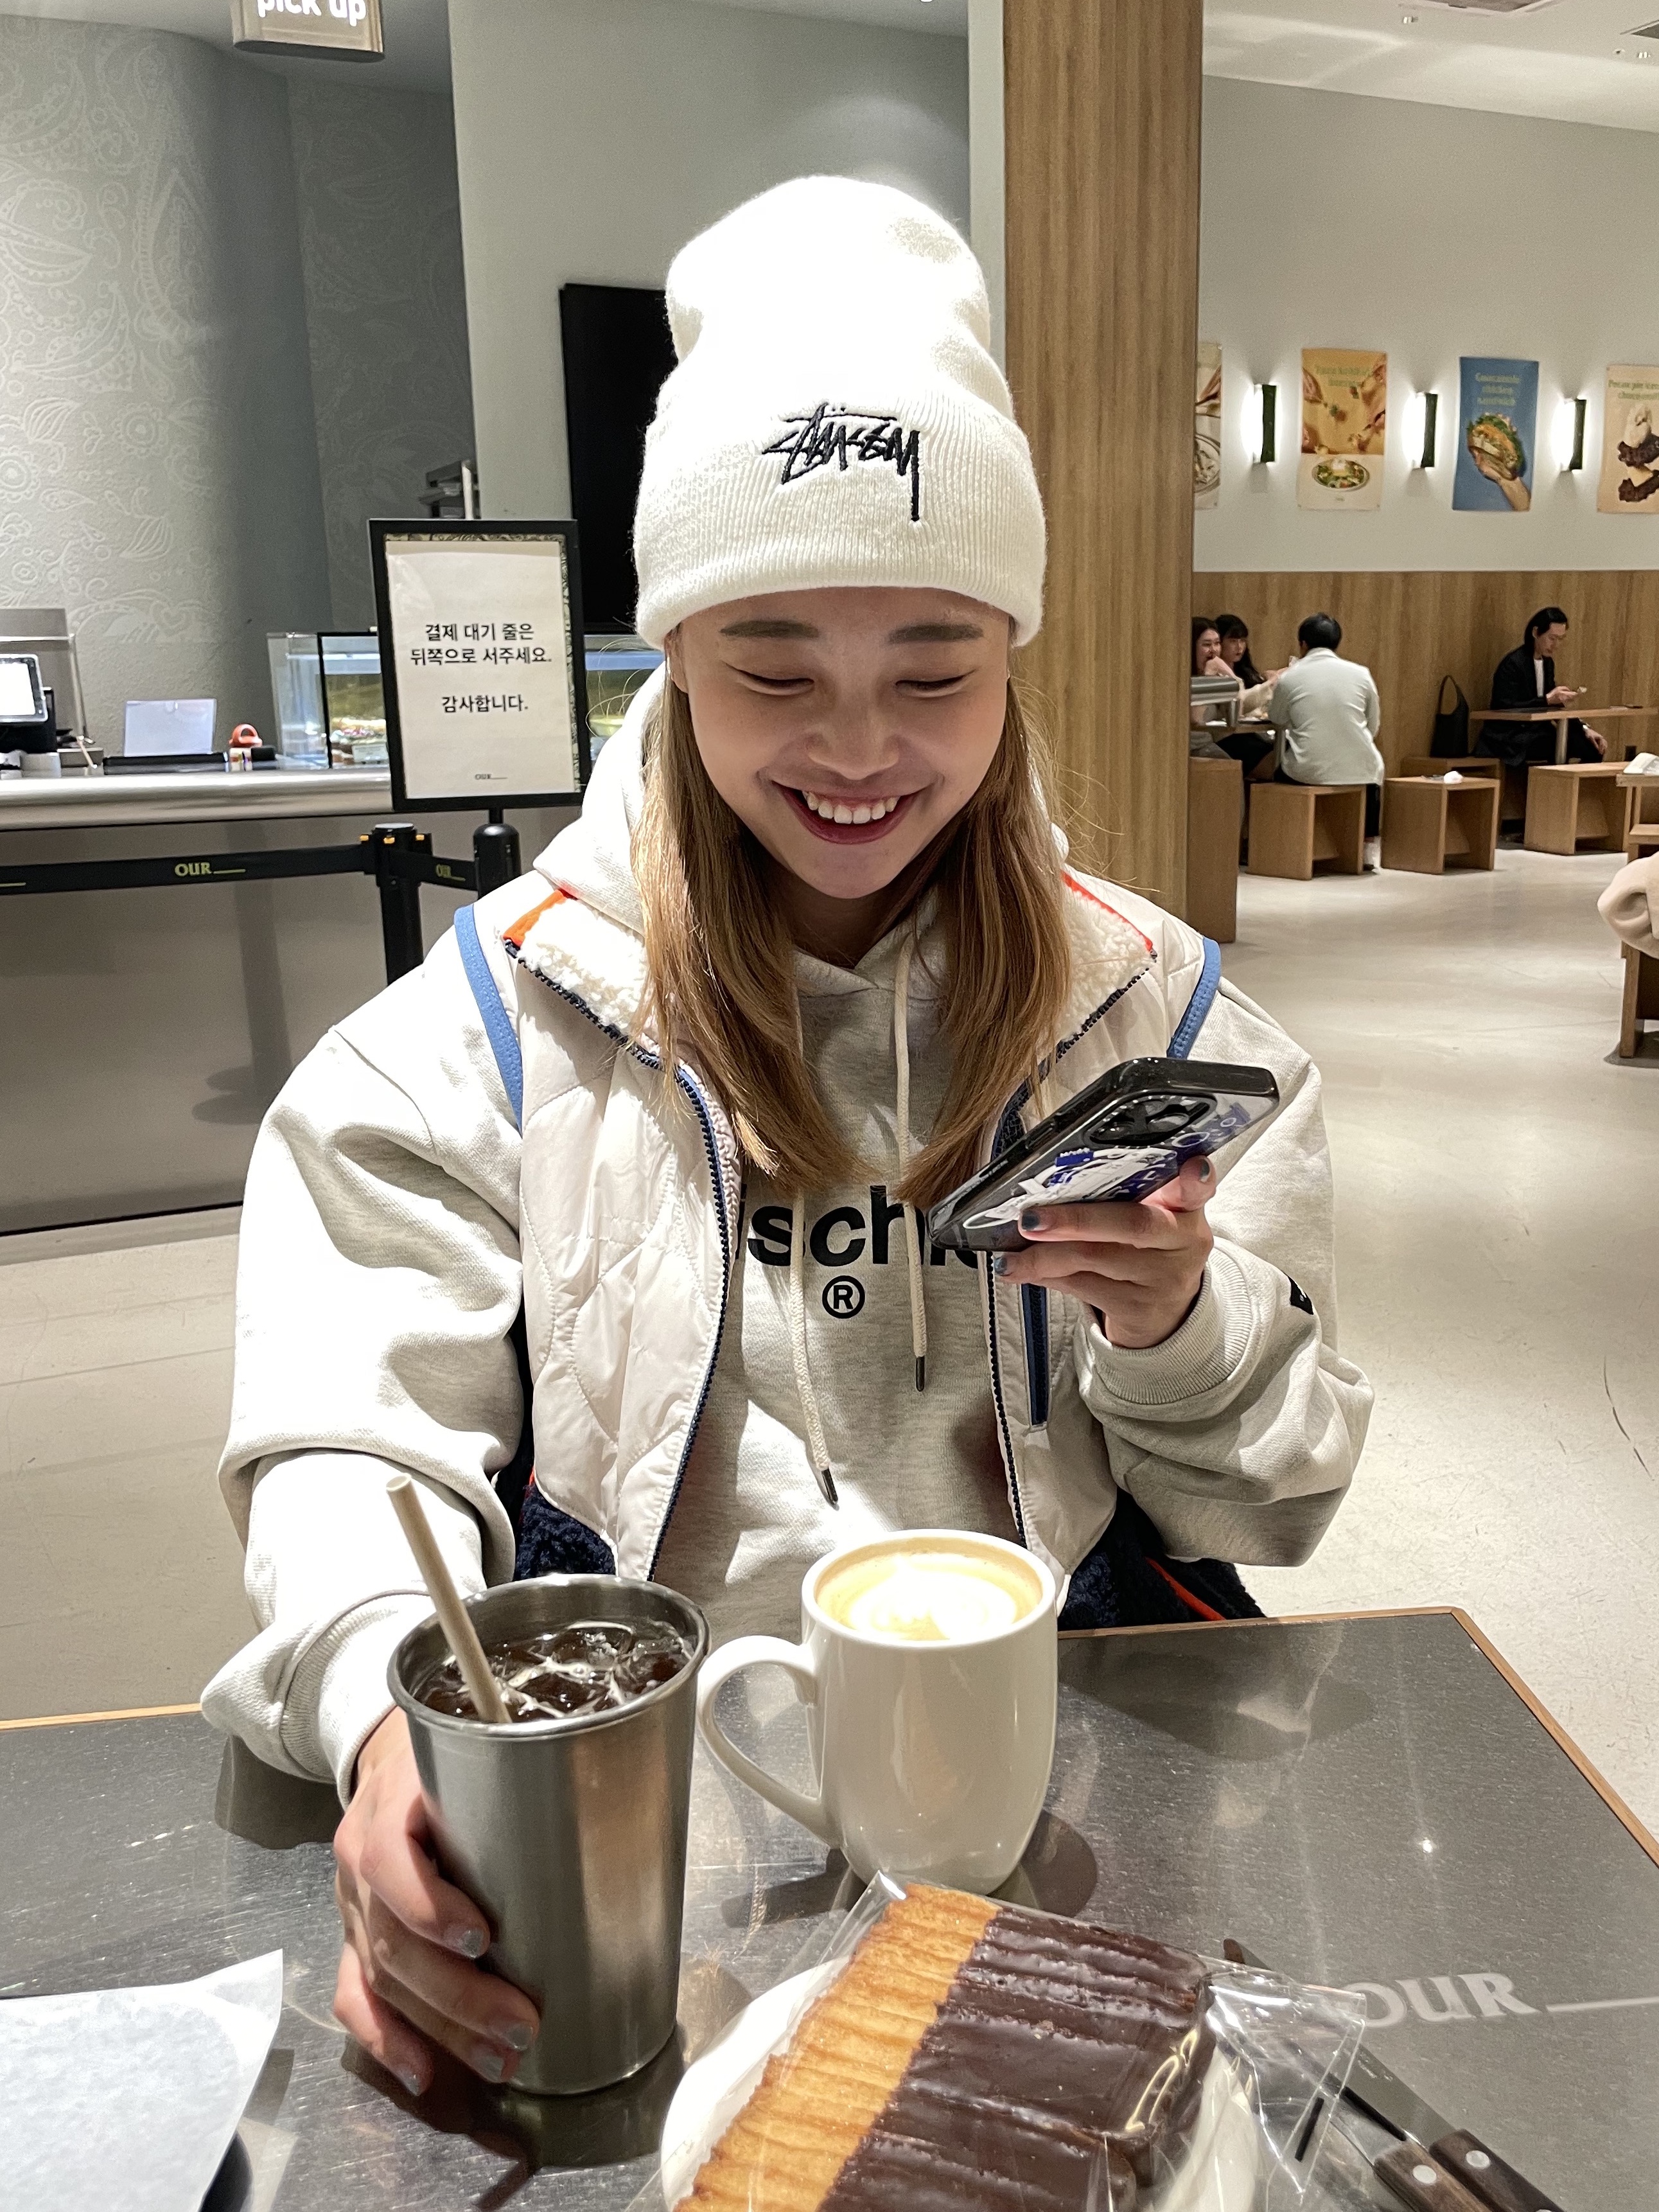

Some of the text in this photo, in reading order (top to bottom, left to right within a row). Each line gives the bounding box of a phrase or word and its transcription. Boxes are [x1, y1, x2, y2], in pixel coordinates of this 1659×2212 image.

[328, 0, 367, 26] up
[426, 623, 534, 641] 결제 대기 줄은
[410, 646, 552, 666] 뒤쪽으로 서주세요.
[442, 694, 529, 713] 감사합니다.
[174, 862, 212, 877] OUR
[1343, 1972, 1541, 2027] OUR
